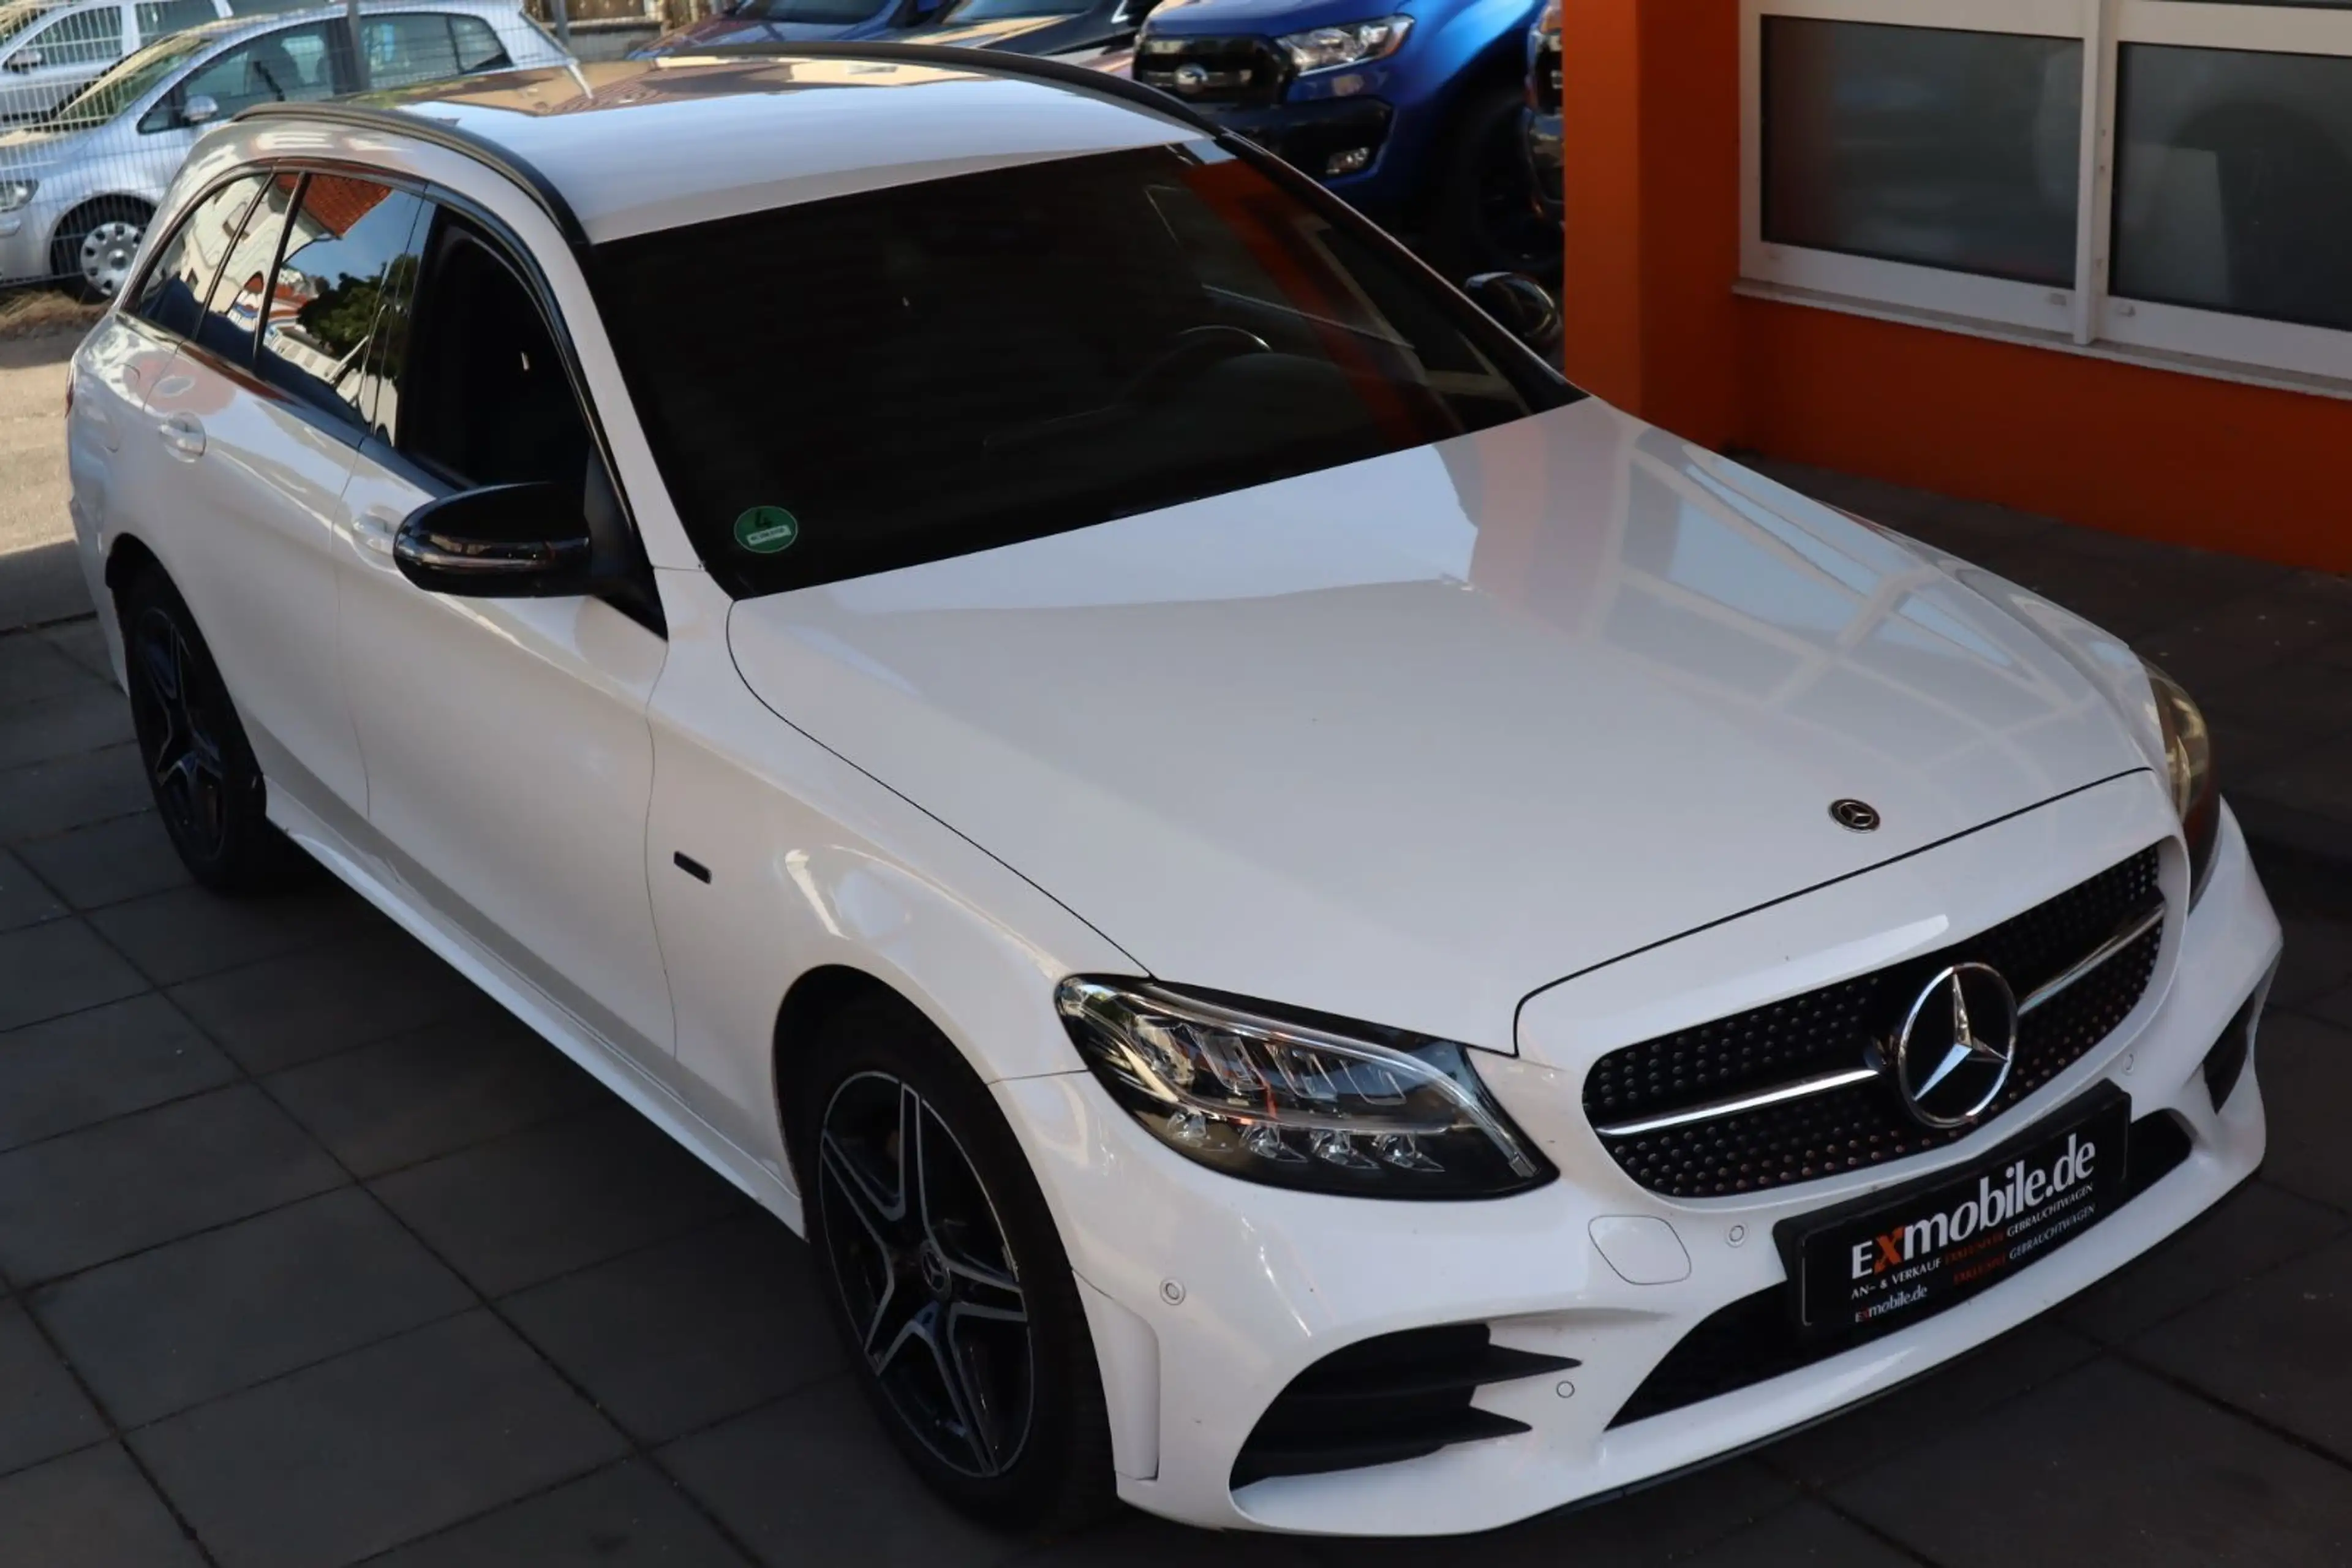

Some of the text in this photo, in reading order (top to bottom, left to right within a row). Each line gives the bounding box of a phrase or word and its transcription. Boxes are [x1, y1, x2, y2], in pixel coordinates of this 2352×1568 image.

[755, 509, 773, 529] 4
[1851, 1284, 1877, 1300] AN-
[1880, 1278, 1888, 1289] &
[1891, 1257, 1941, 1285] VERKAUF
[2006, 1182, 2094, 1237] GEBRAUCHTWAGEN
[2009, 1202, 2096, 1259] GEBRAUCHTWAGEN
